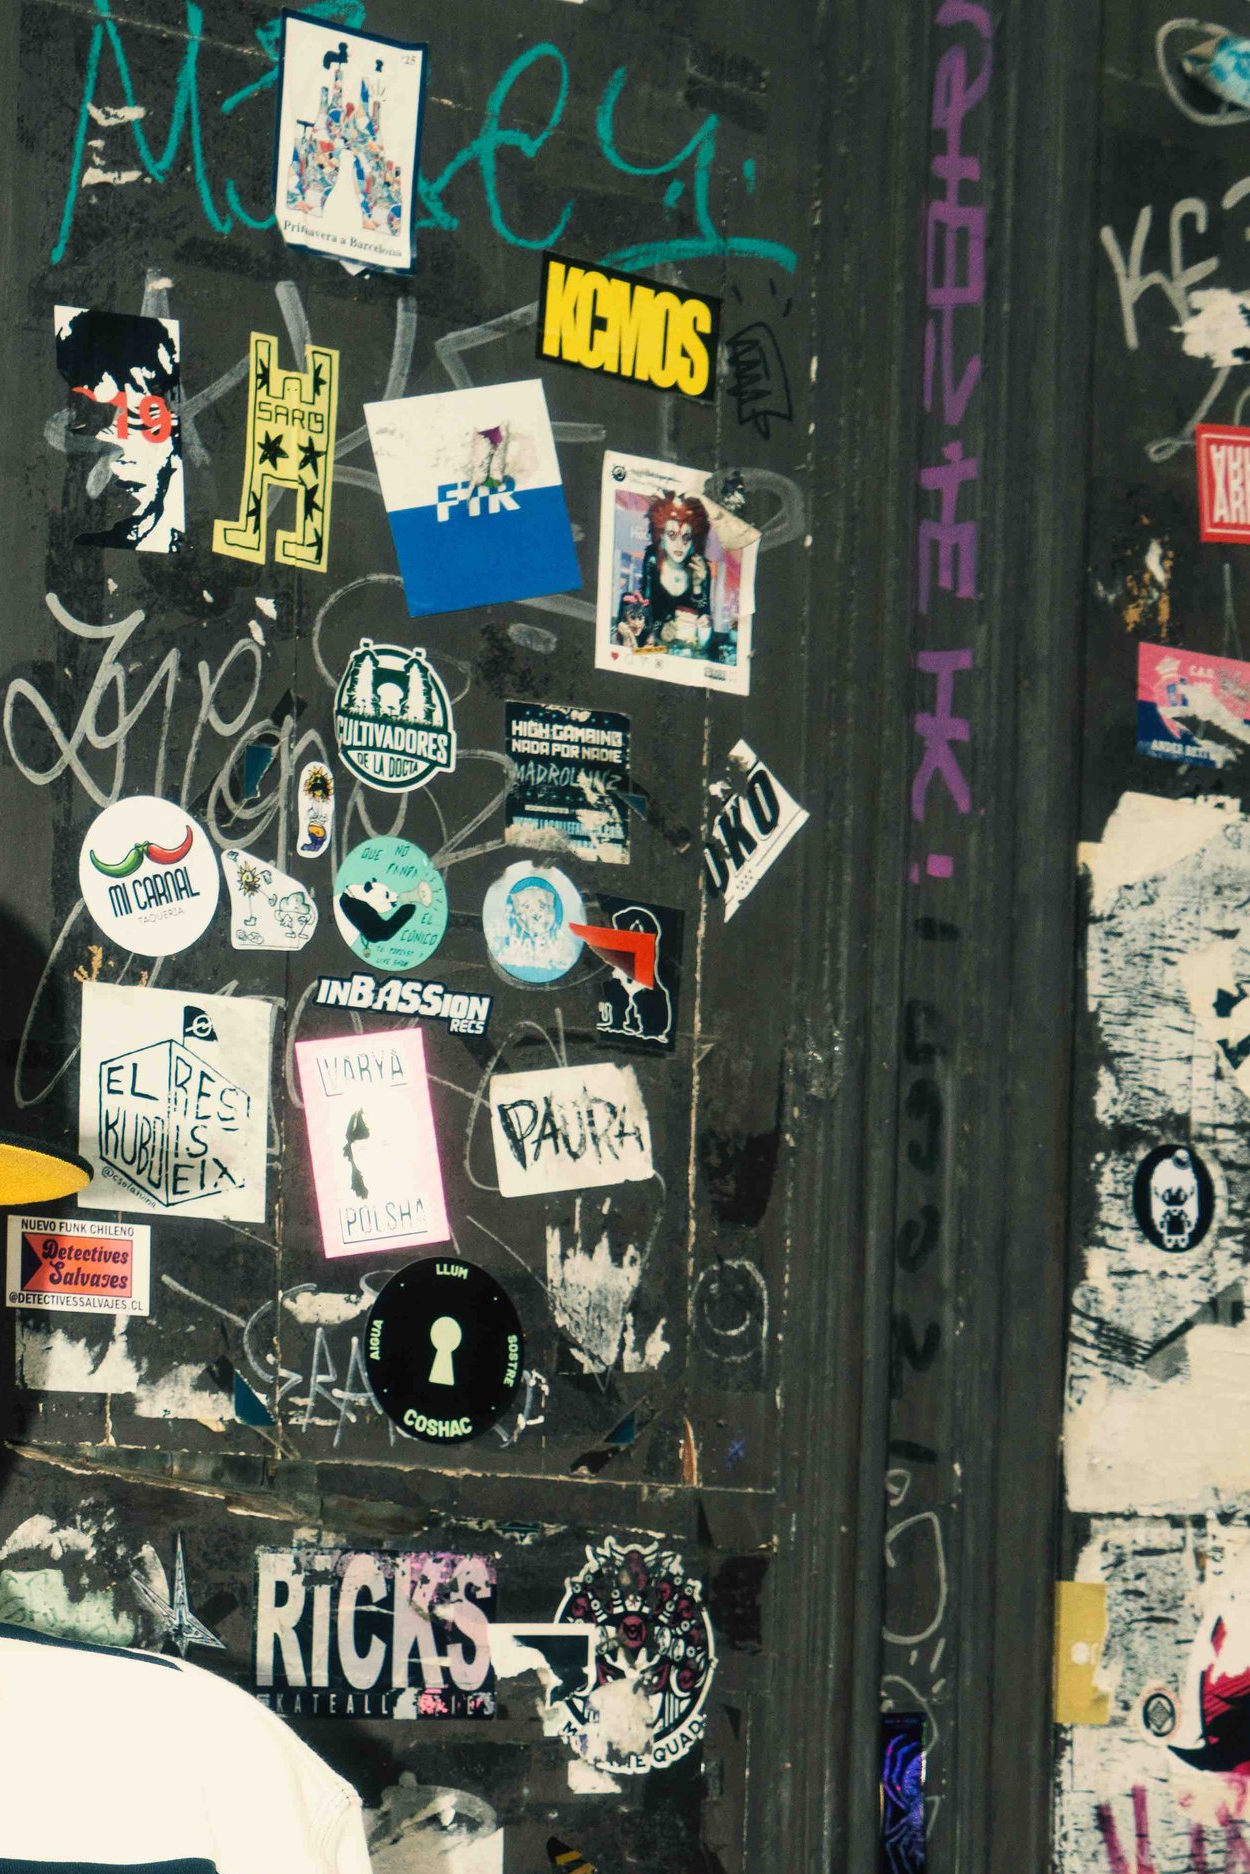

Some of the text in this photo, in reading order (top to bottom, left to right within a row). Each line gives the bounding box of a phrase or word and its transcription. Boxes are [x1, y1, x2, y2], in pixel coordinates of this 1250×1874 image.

[283, 218, 338, 243] Primavera
[349, 237, 403, 257] Barcelona
[336, 714, 449, 765] CULTIVADORES
[511, 719, 550, 739] HIGH
[357, 752, 419, 778] DE LA DOCTA
[511, 738, 623, 763] NADA POR NADIE
[361, 845, 410, 861] QUE NO
[108, 866, 200, 919] MI CARNAL
[420, 912, 432, 926] EL
[450, 1018, 485, 1035] RECS
[106, 1062, 159, 1101] EL
[497, 1084, 645, 1171] PAURA
[104, 1106, 165, 1190] KUBO
[21, 1218, 135, 1238] NUEVO FUNK CHILENO
[42, 1237, 129, 1265] Detectives
[48, 1260, 129, 1289] Salvajes
[435, 1263, 469, 1280] LLUM
[369, 1319, 384, 1361] AIGUA
[502, 1334, 519, 1388] SOSTRE
[402, 1408, 474, 1438] COSHAC
[255, 1552, 492, 1692] RICKS
